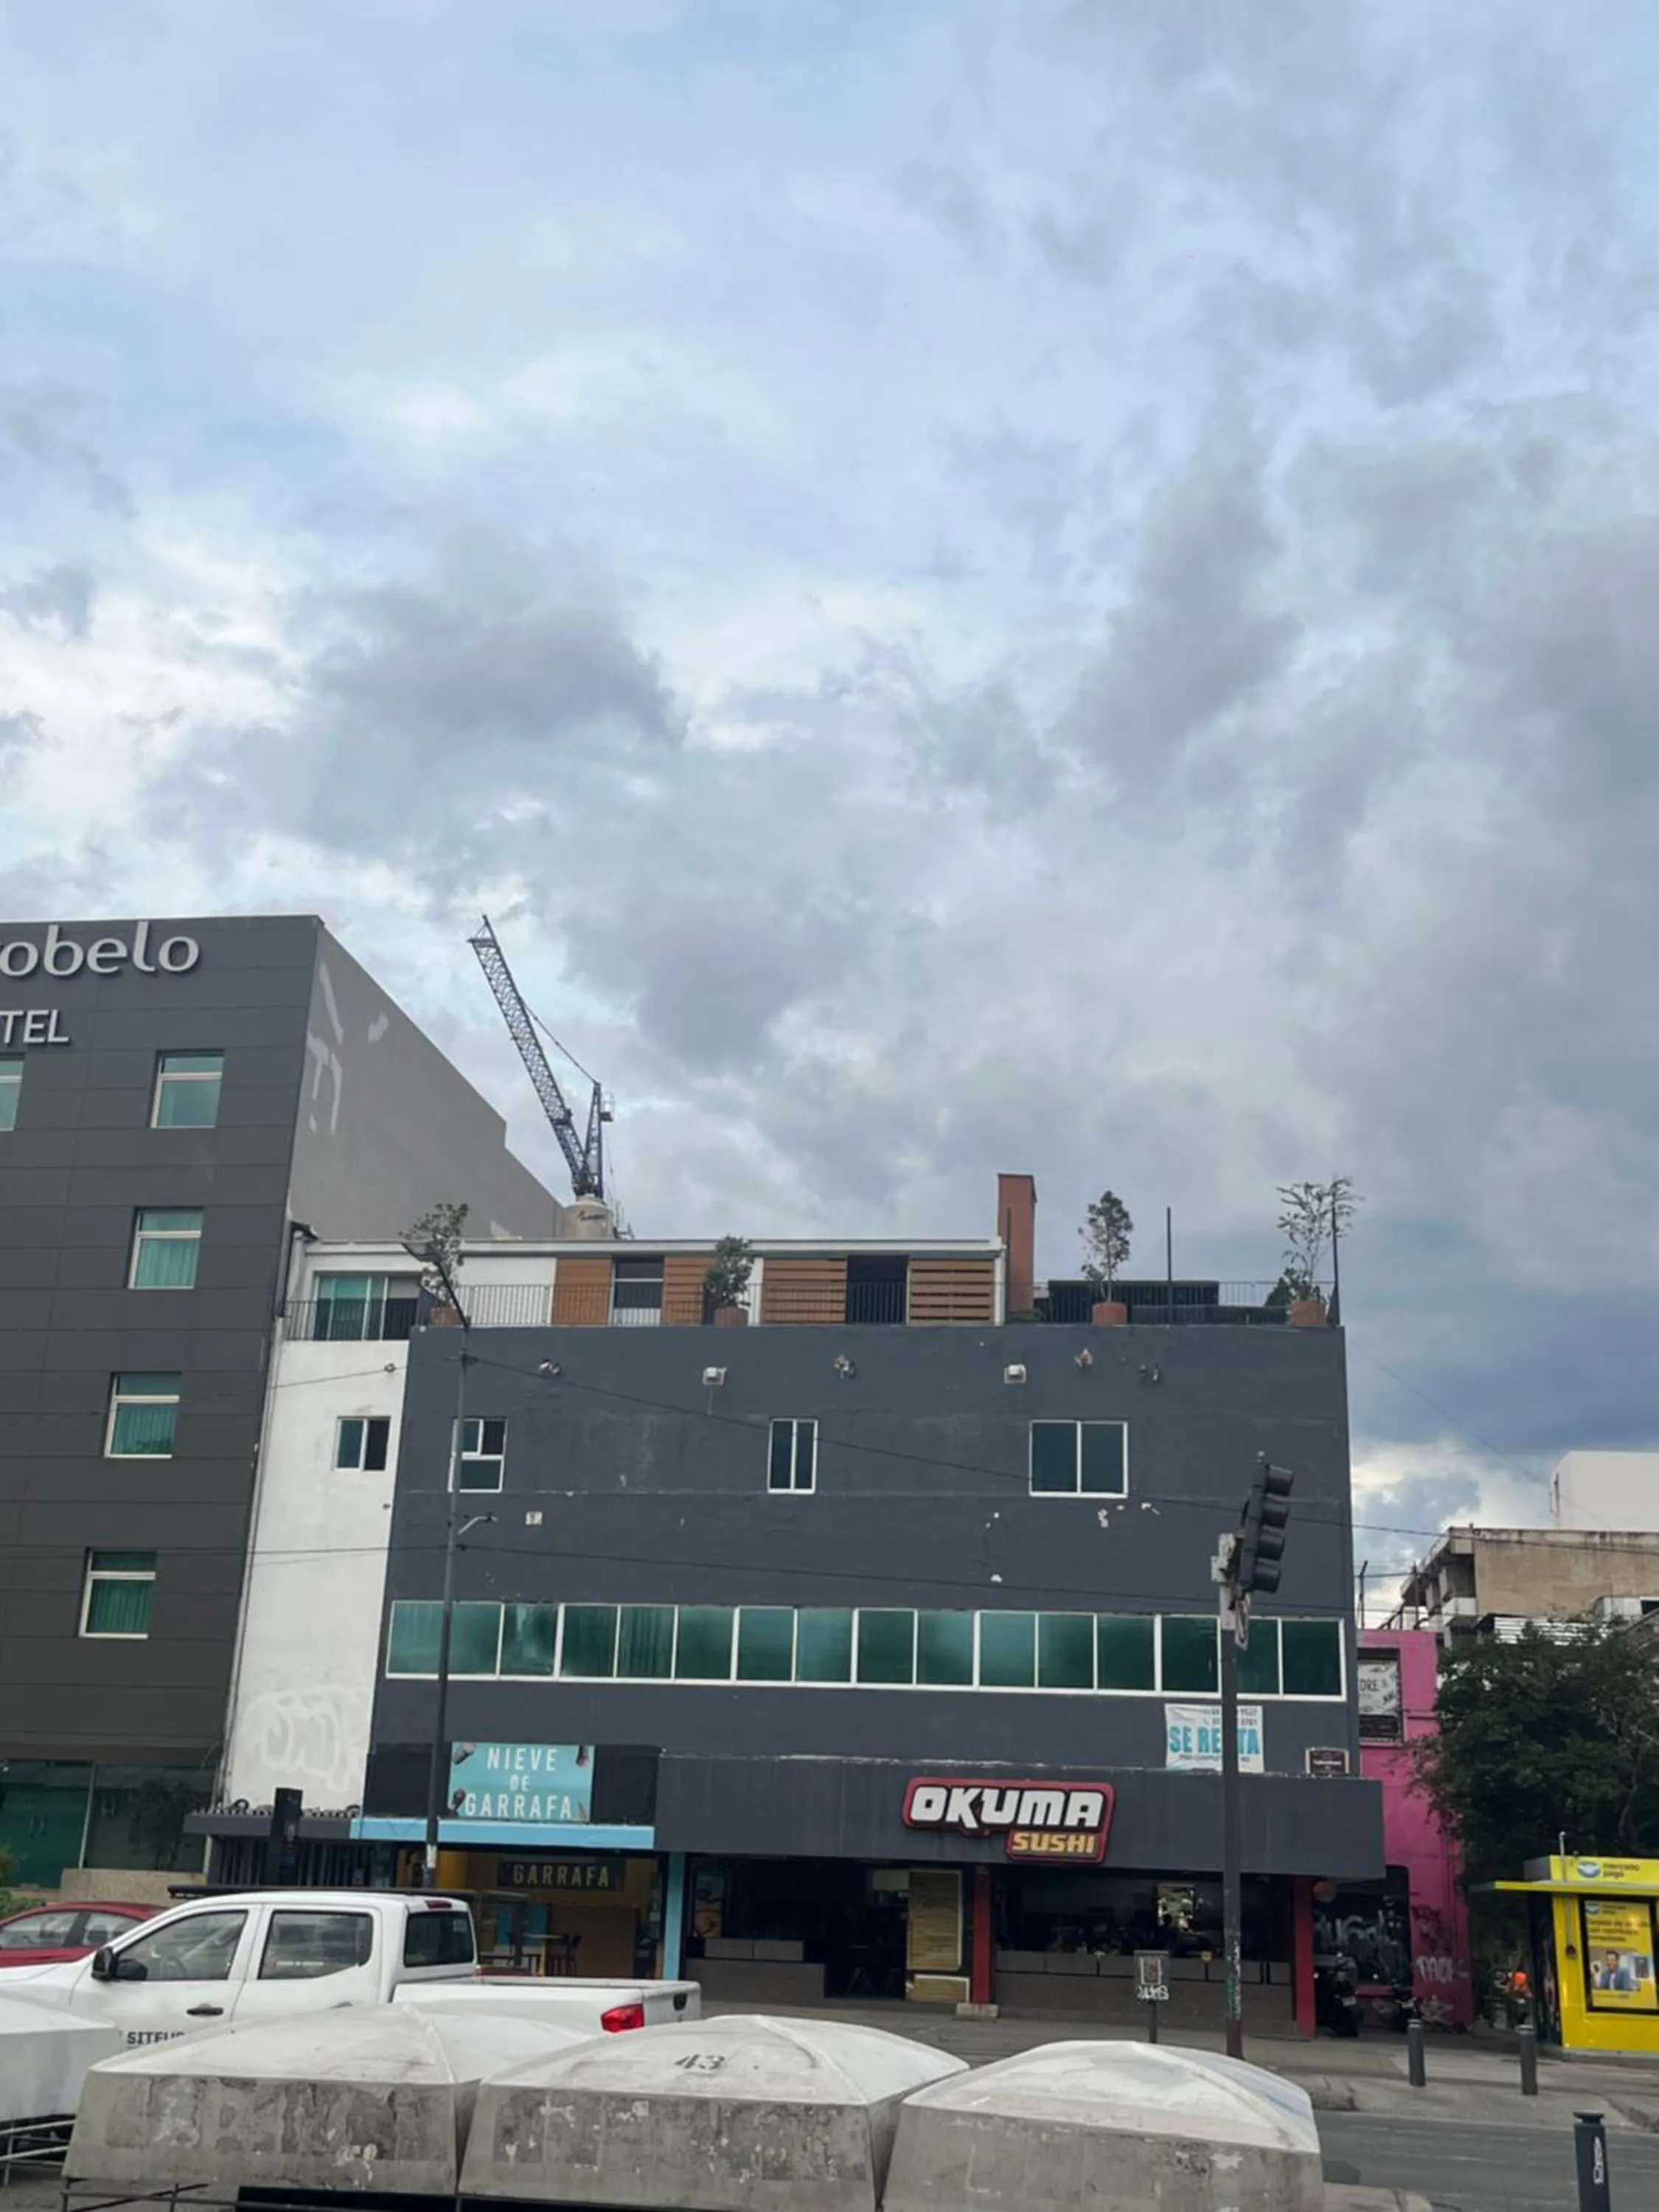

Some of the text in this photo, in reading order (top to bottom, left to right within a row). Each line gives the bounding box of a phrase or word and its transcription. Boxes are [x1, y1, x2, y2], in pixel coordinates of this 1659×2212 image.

[1169, 1726, 1260, 1755] SE RETA
[487, 1747, 558, 1771] NIEVE
[510, 1774, 529, 1792] DE
[465, 1792, 572, 1820] GARRAFA
[910, 1786, 1104, 1829] OKUMA
[1011, 1832, 1096, 1854] SUSHI
[512, 1863, 610, 1888] GARRAFA
[674, 2053, 726, 2070] 43
